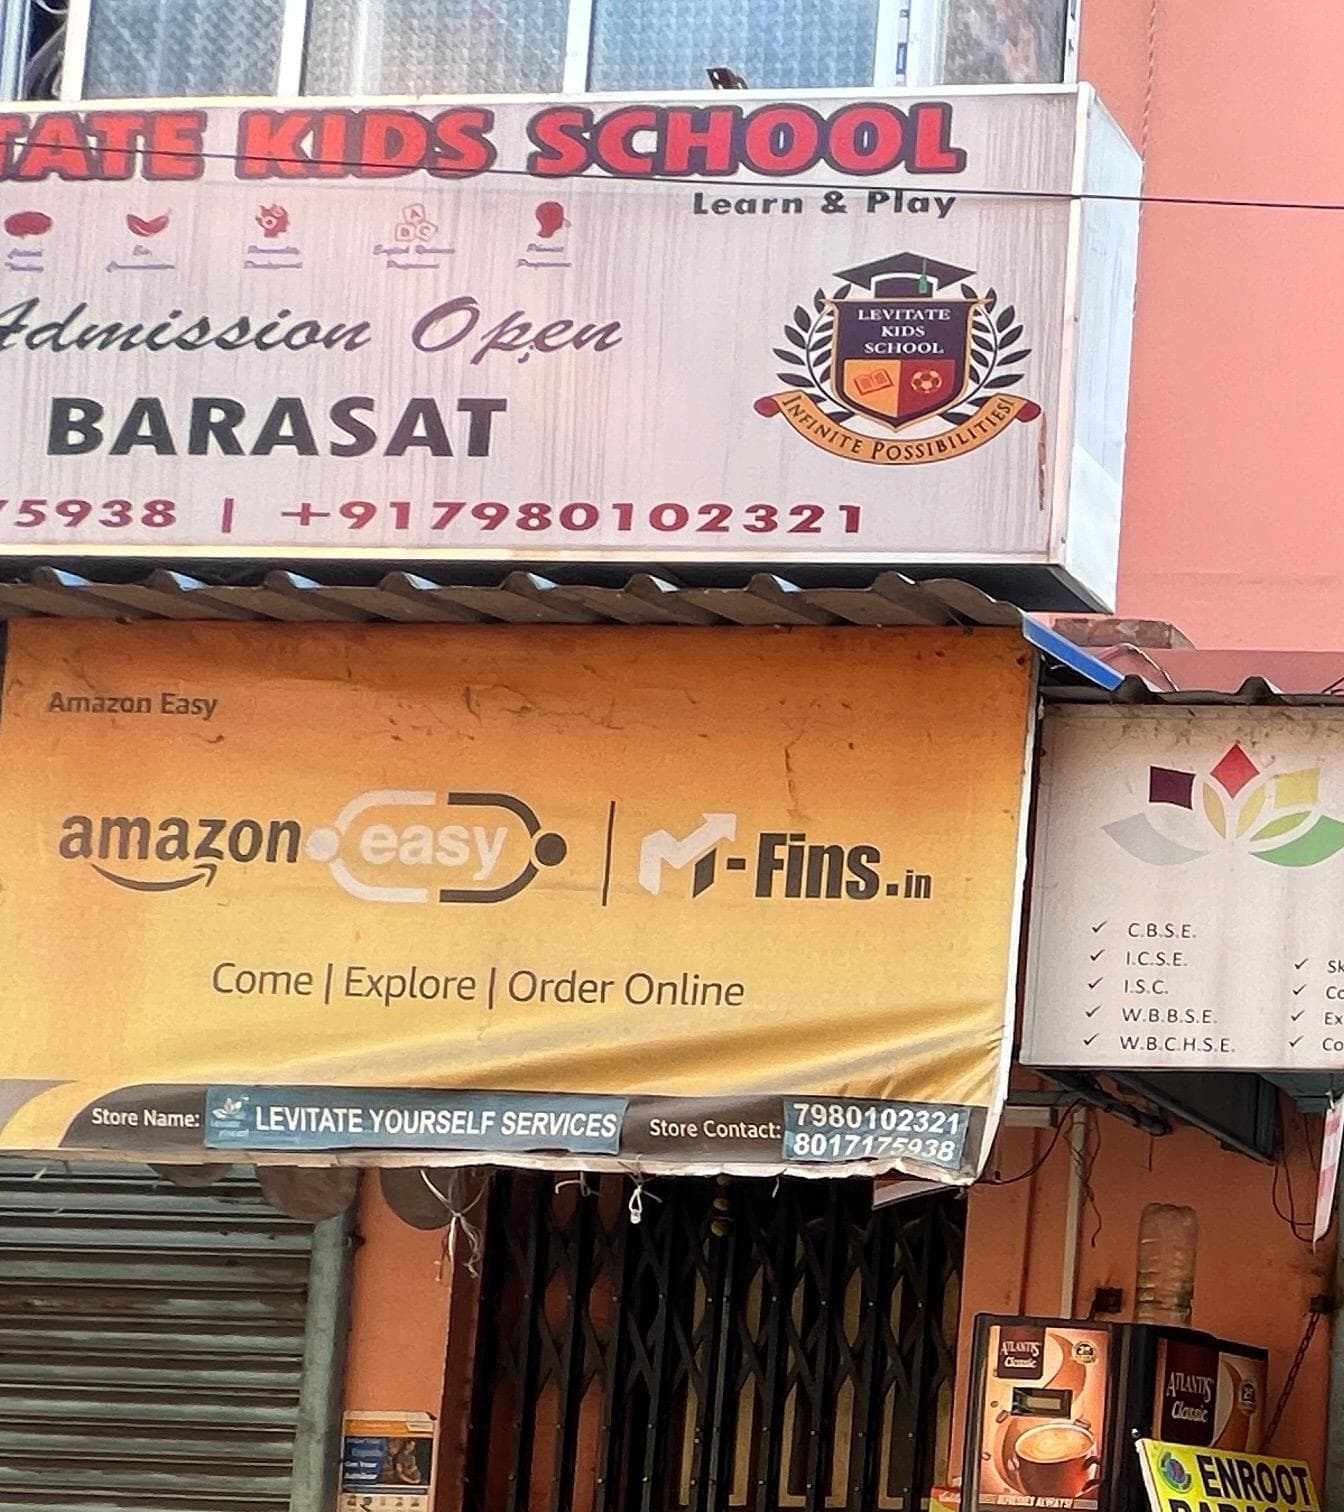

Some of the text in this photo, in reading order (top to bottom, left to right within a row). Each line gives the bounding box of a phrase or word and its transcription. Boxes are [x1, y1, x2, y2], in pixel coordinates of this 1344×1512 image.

[234, 106, 497, 180] KIDS
[527, 101, 967, 179] SCHOOL
[693, 190, 957, 218] Learn & Play
[0, 295, 623, 365] Admission Open
[857, 307, 952, 355] LEVITATE KIDS SCHOOL
[46, 396, 508, 457] BARASAT
[782, 395, 862, 454] INFINITE
[281, 500, 862, 533] +917980102321
[47, 690, 218, 720] Amazon Easy
[58, 814, 301, 864] amazon
[359, 820, 508, 881] easy
[1127, 922, 1197, 940] C.B.S.E.
[1125, 951, 1188, 967] I.C.S.E.
[212, 962, 745, 1007] Come Explore Order Online
[1123, 979, 1169, 995] I.S.C.
[1121, 1007, 1218, 1025] W.B.B.S.E.
[1119, 1035, 1236, 1054] W.B.C.H.S.E.
[91, 1108, 201, 1130] Store Name:
[255, 1106, 617, 1138] LEVITATE YOURSELF SERVICES
[650, 1118, 782, 1140] Store Contact:
[794, 1103, 960, 1135] 7980102321
[793, 1133, 955, 1162] 8017175938
[1196, 1454, 1310, 1507] ENROOT
